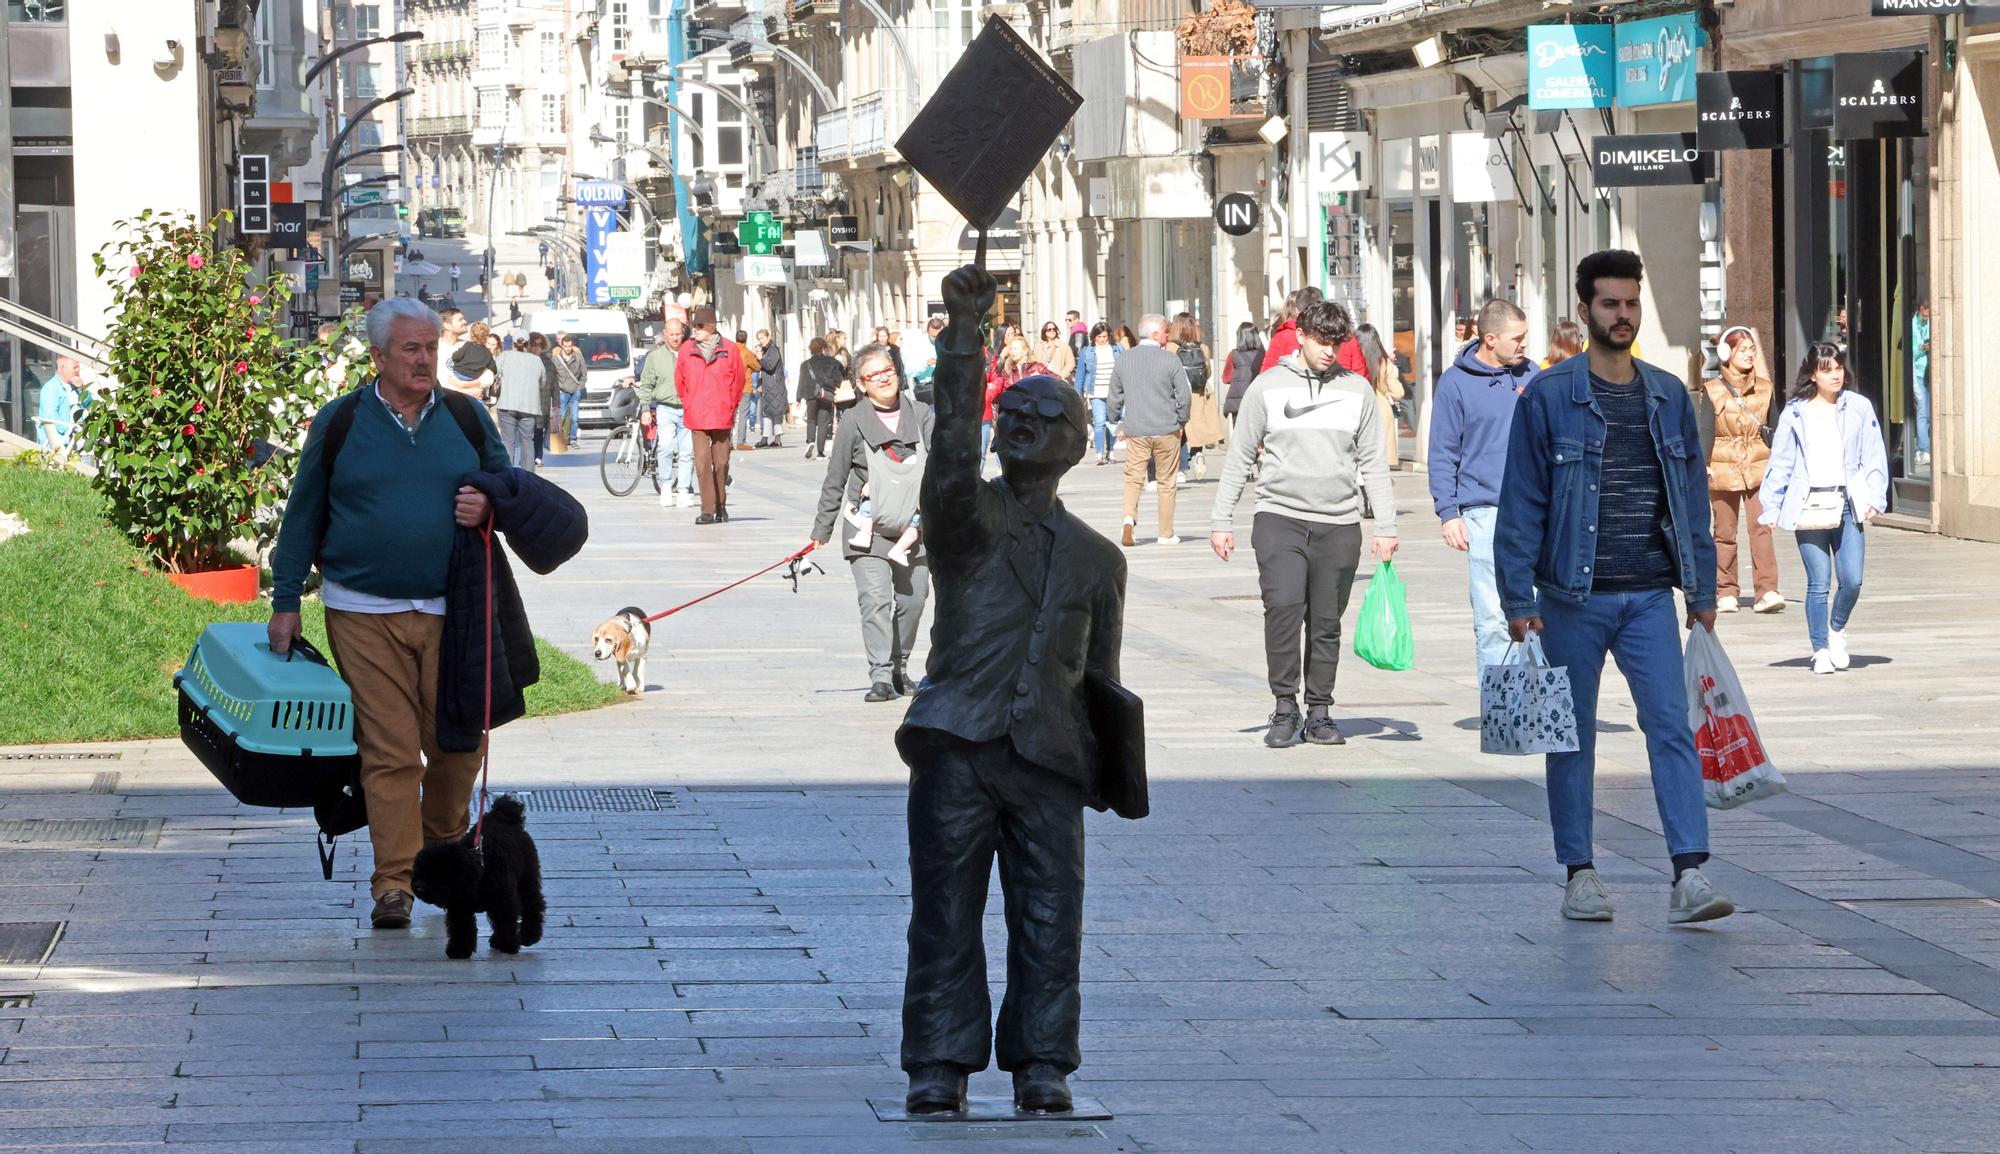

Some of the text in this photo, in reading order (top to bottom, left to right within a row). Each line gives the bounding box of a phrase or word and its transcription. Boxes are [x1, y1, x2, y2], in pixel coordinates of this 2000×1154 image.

[1536, 87, 1607, 98] COMERCIAL
[1840, 95, 1917, 106] SCALPERS
[1701, 110, 1772, 121] SCALPERS
[1600, 149, 1699, 165] DIMIKELO
[577, 184, 624, 202] COLEXIO
[1224, 203, 1251, 226] IN
[831, 226, 857, 234] OYSHO
[592, 211, 612, 302] VIVAS
